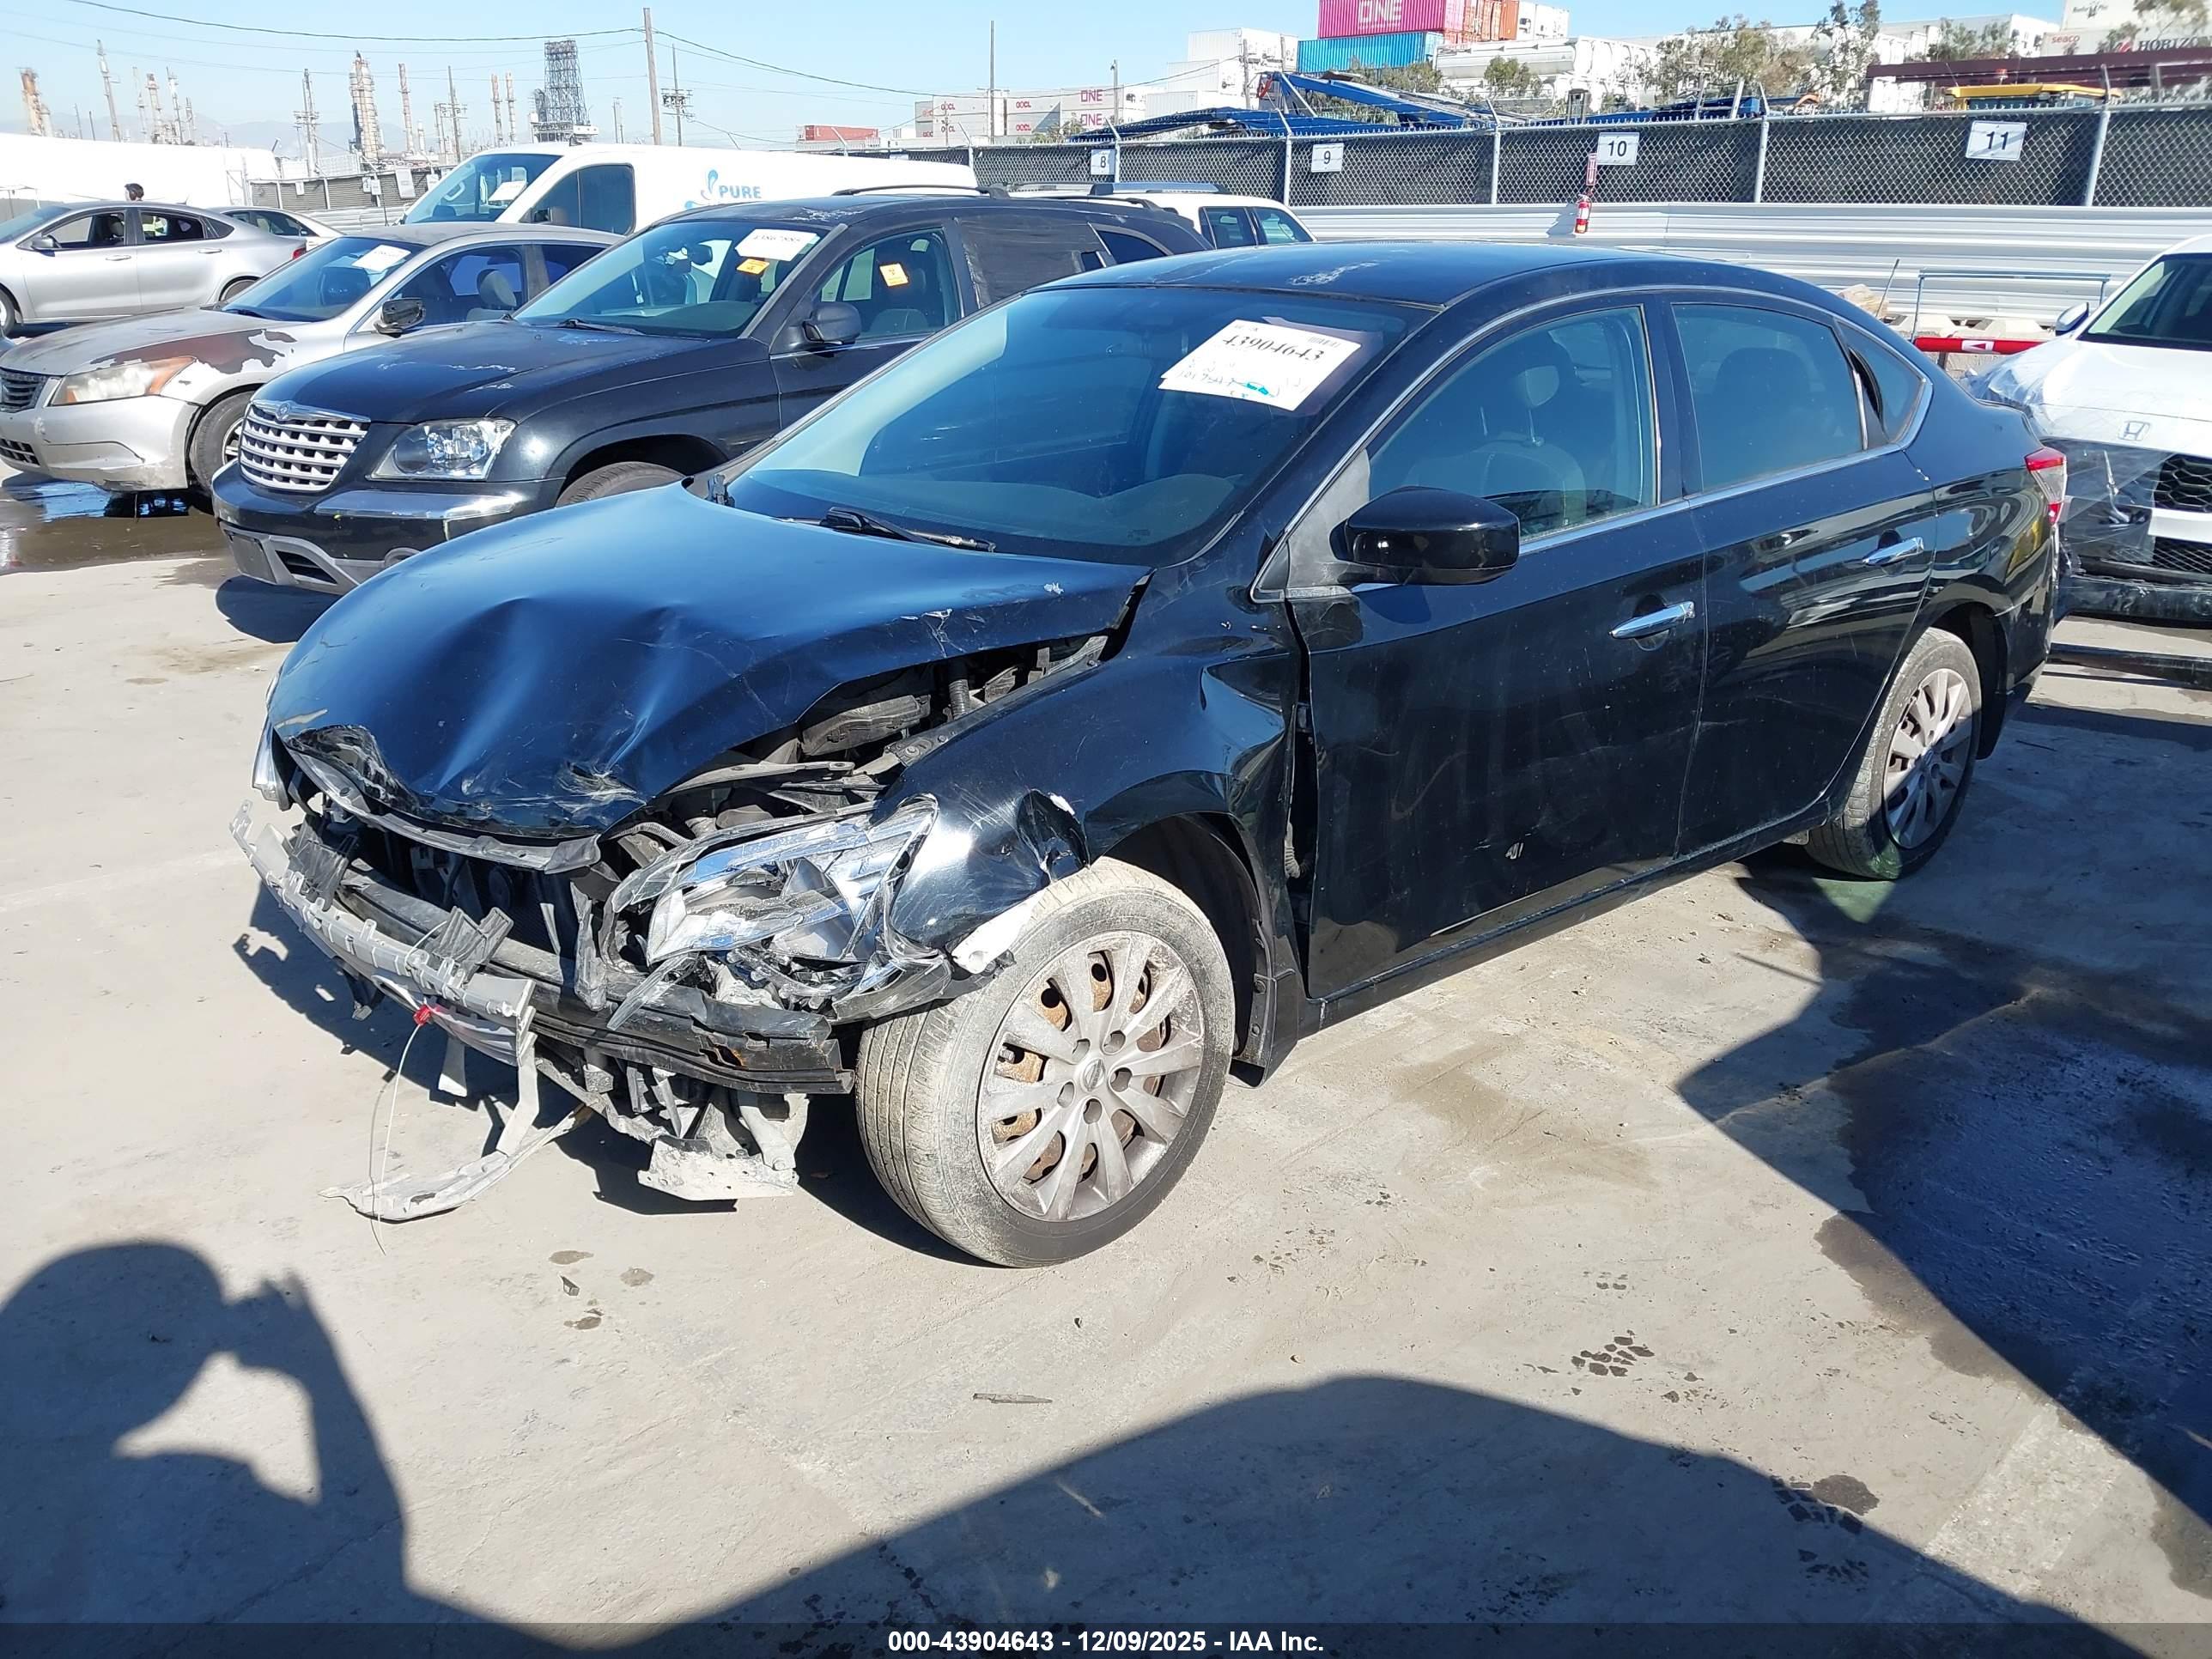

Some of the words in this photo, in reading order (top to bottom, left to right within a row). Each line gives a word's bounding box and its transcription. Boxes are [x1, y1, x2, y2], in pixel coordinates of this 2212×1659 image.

[1358, 0, 1402, 22] ONE
[2051, 35, 2081, 44] seaco
[1080, 89, 1103, 102] ONE
[1080, 113, 1103, 126] ONE
[1986, 131, 2009, 150] 11
[1607, 140, 1627, 157] 10
[1100, 155, 1107, 168] 8
[1323, 150, 1331, 164] 9
[719, 185, 762, 199] PURE
[1222, 335, 1325, 361] 43904643
